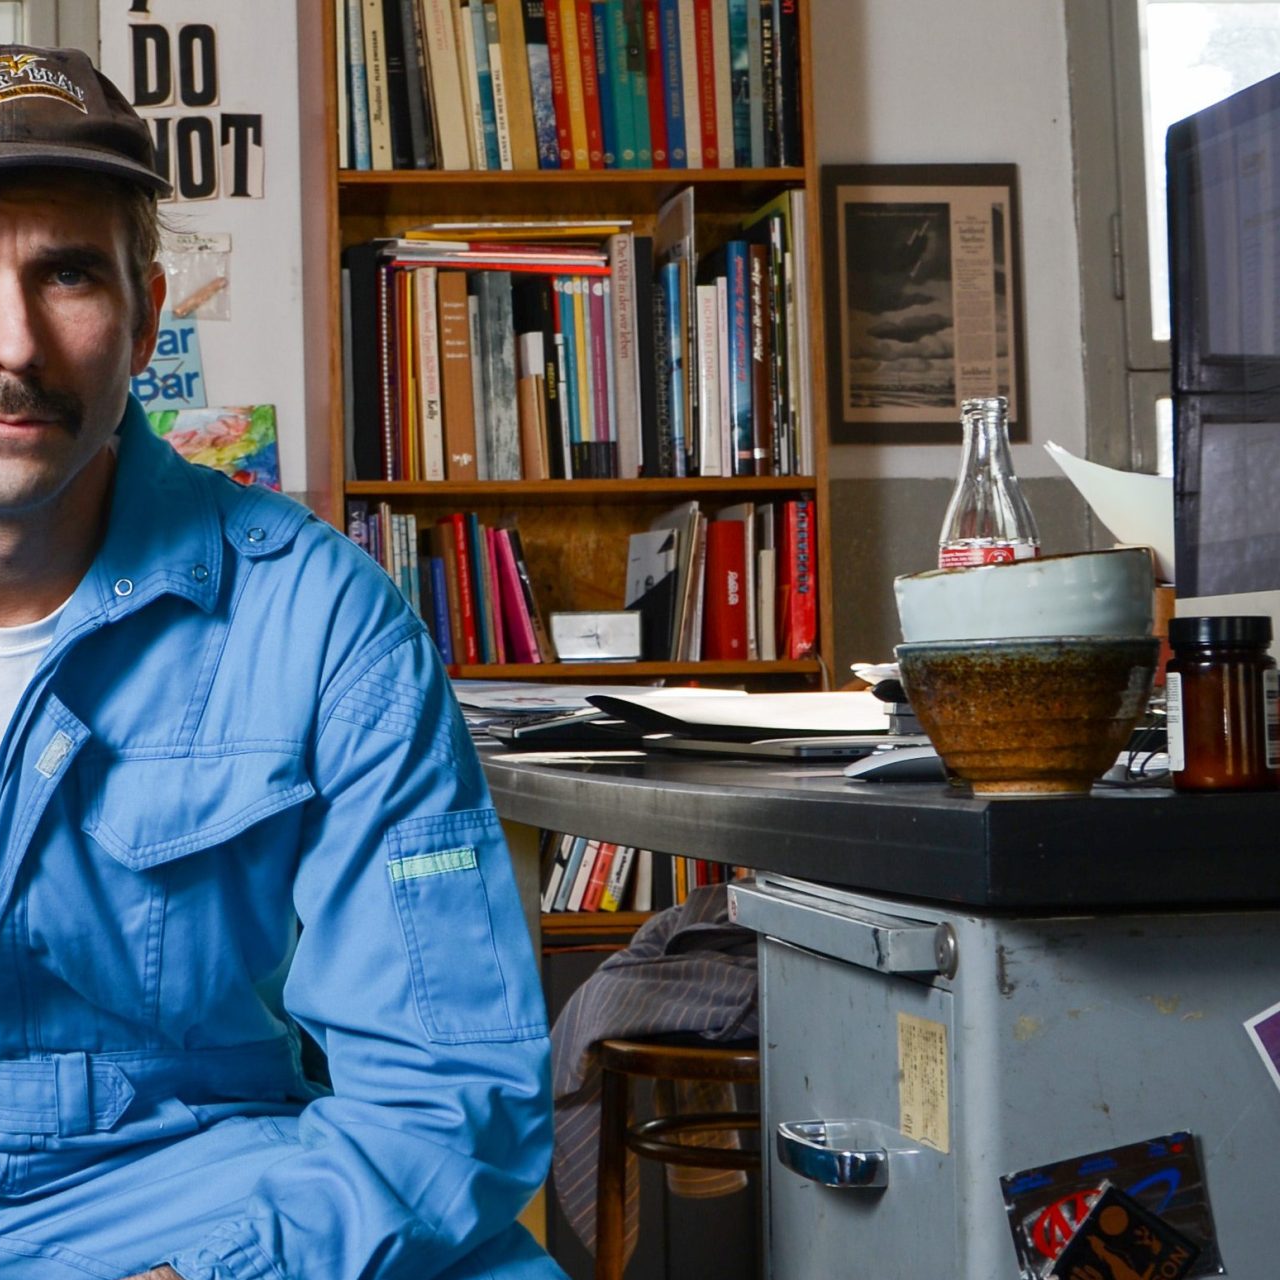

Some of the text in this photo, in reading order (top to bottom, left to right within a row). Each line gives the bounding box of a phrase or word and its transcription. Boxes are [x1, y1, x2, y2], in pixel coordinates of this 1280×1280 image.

[128, 24, 216, 107] DO
[763, 18, 773, 66] TIERE
[143, 113, 262, 201] NOT
[616, 239, 631, 359] Die Welt in der wir leben
[131, 366, 199, 402] Bar
[703, 298, 714, 390] RICHARD LONG
[426, 398, 436, 421] Kelly
